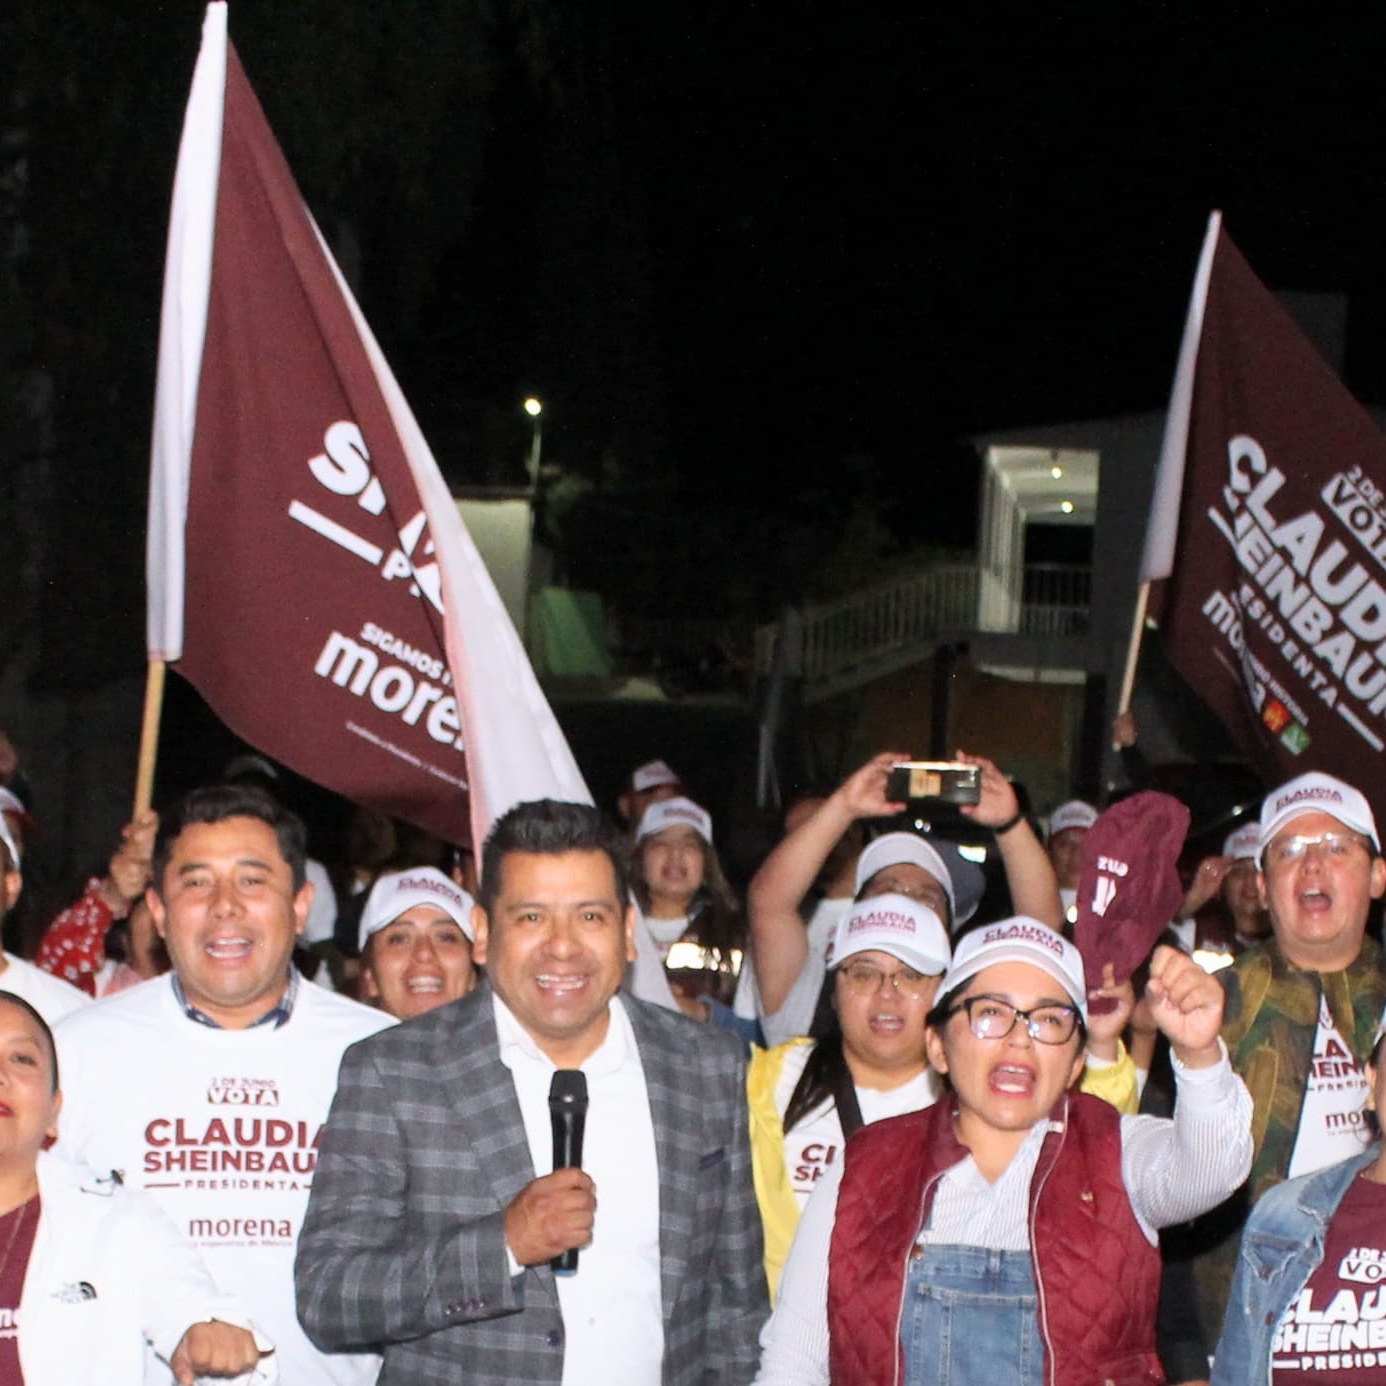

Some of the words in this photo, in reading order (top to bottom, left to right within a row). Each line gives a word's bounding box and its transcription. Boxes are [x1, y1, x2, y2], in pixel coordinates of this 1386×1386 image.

[1359, 477, 1385, 507] DE
[360, 621, 445, 681] SIGAMOS
[314, 631, 465, 752] more
[208, 1088, 280, 1105] VOTA
[143, 1150, 316, 1174] SHEINBAU
[184, 1179, 300, 1191] PRESIDENTA
[189, 1218, 293, 1238] morena
